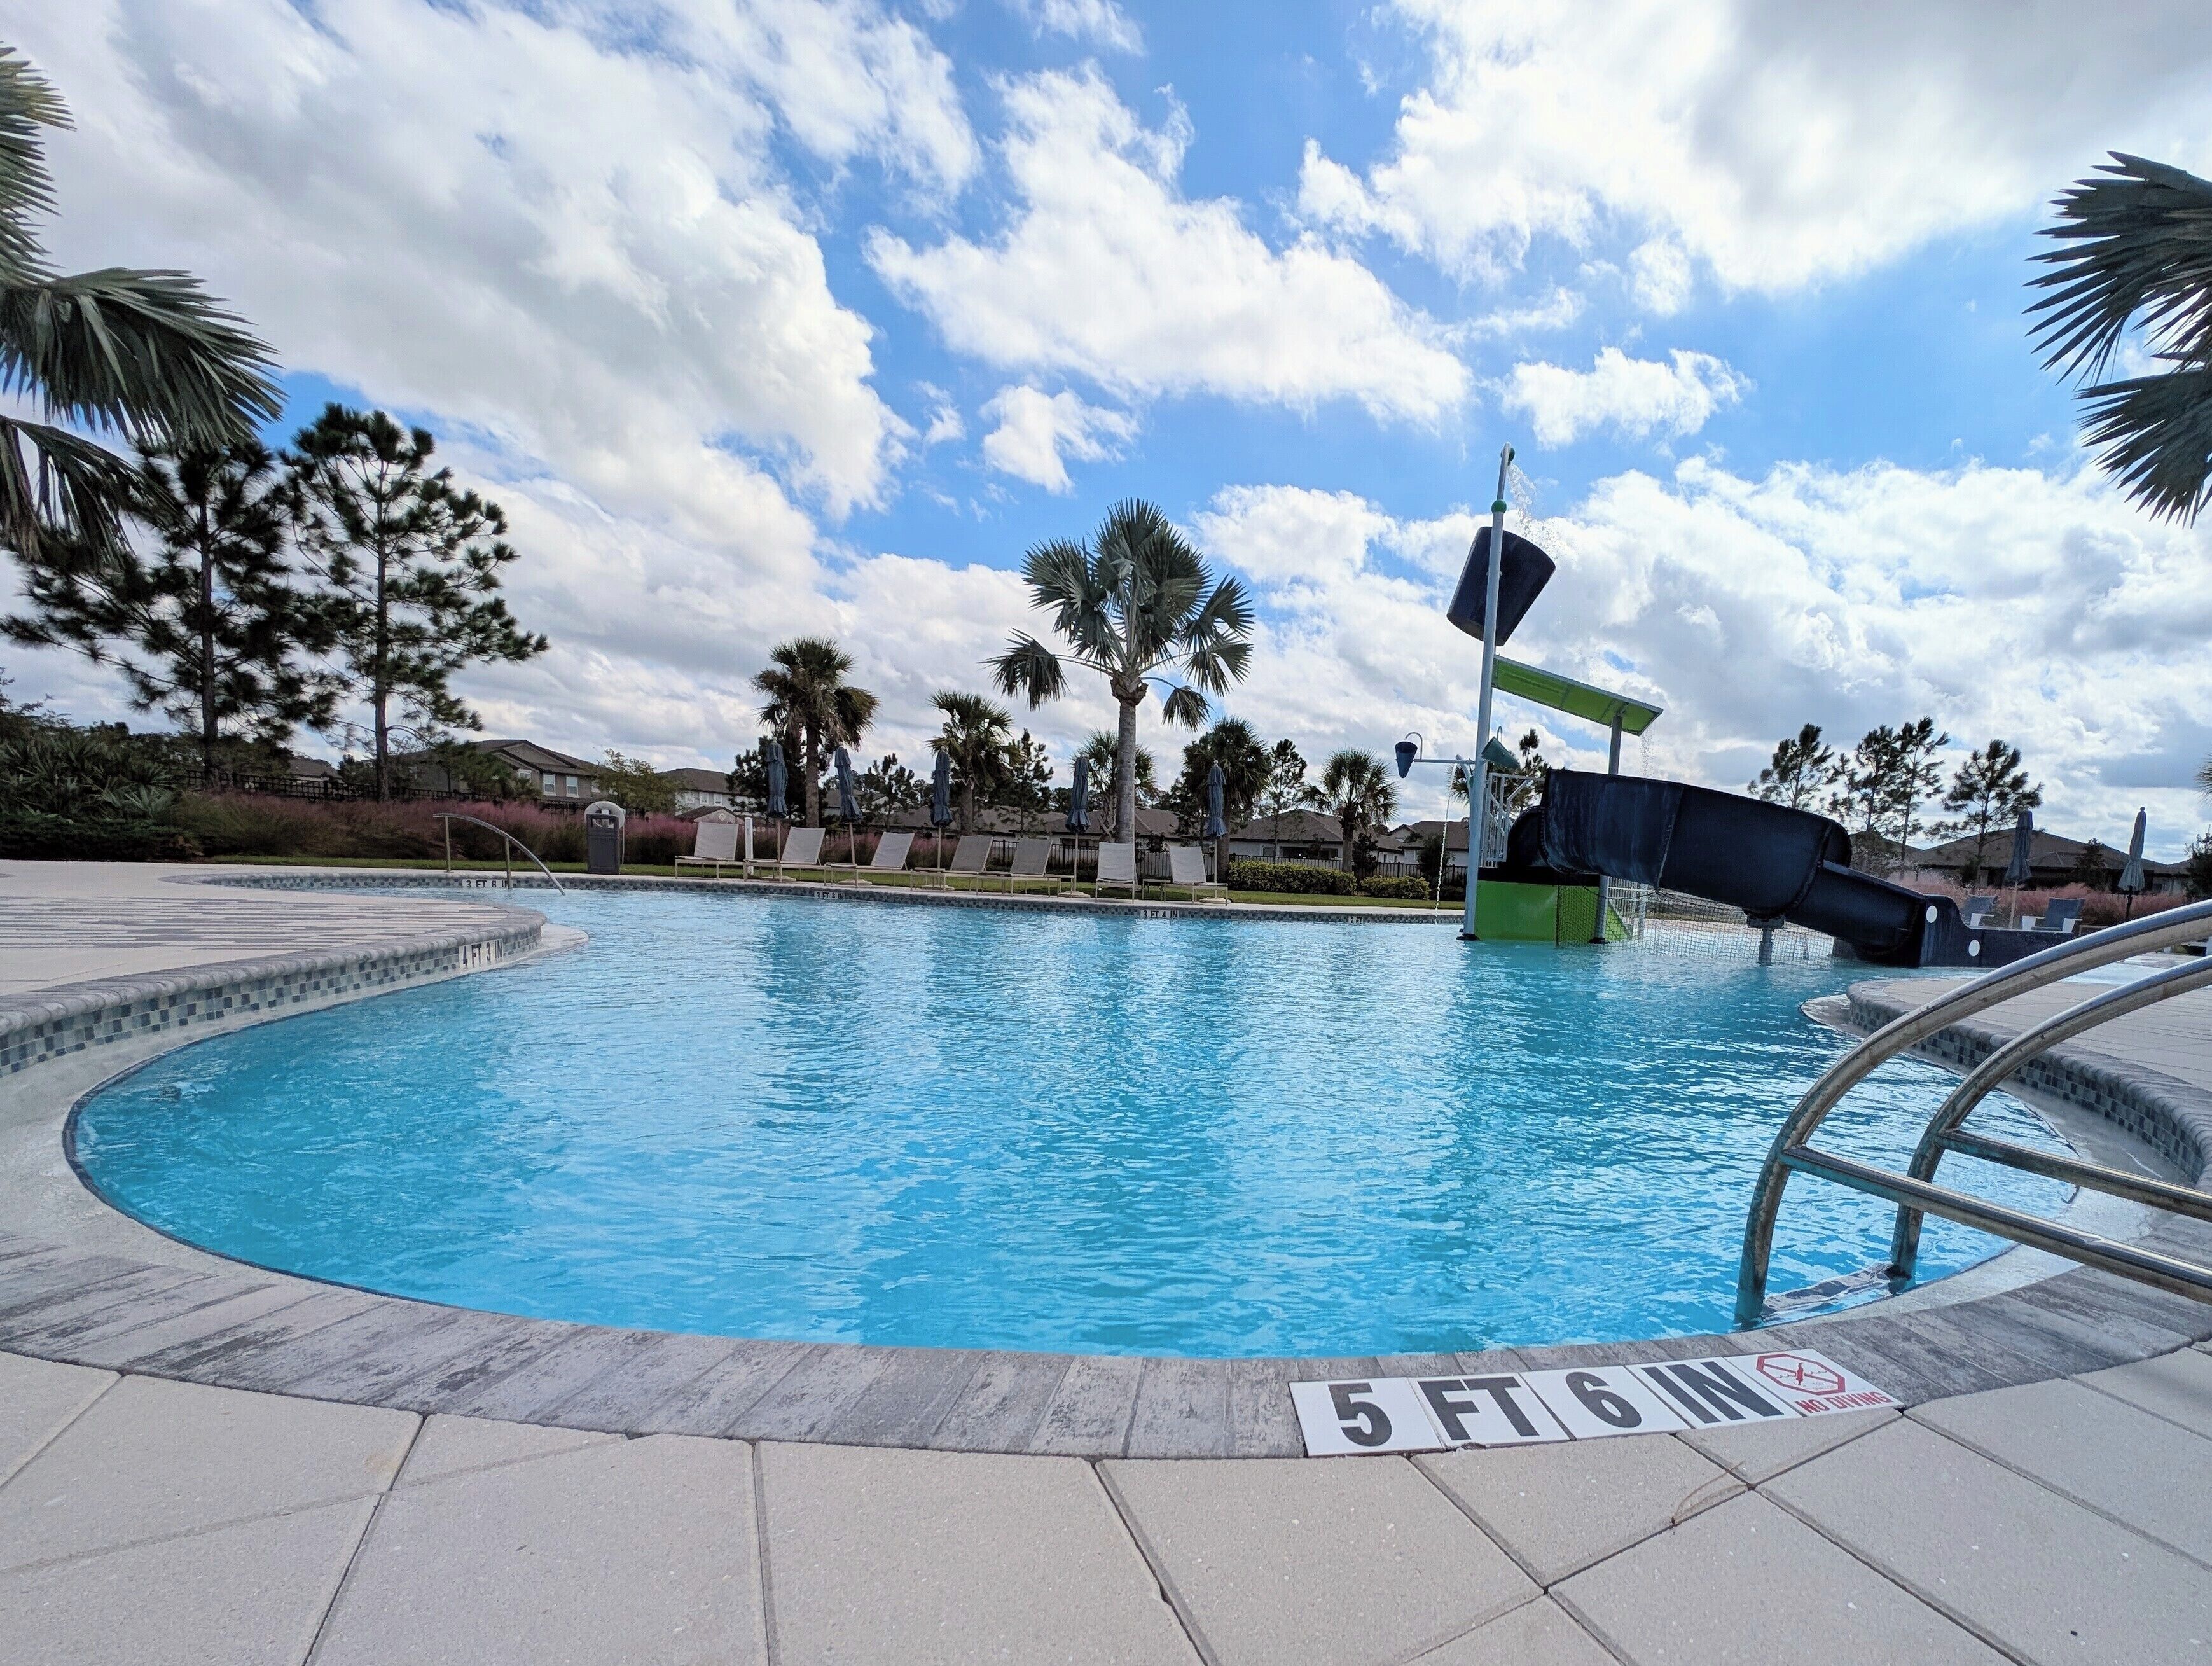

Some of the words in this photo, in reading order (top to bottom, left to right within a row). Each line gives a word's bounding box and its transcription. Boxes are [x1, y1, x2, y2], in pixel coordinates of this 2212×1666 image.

[1170, 910, 1178, 919] IN
[463, 945, 467, 966] 4
[471, 943, 482, 967] FT
[486, 941, 491, 961] 3
[494, 940, 502, 959] IN
[1327, 1382, 1392, 1447] 5
[1417, 1376, 1540, 1440] FT
[1565, 1371, 1642, 1428] 6
[1640, 1361, 1785, 1424] IN
[1794, 1399, 1830, 1413] NO
[1823, 1391, 1894, 1410] DIVING
